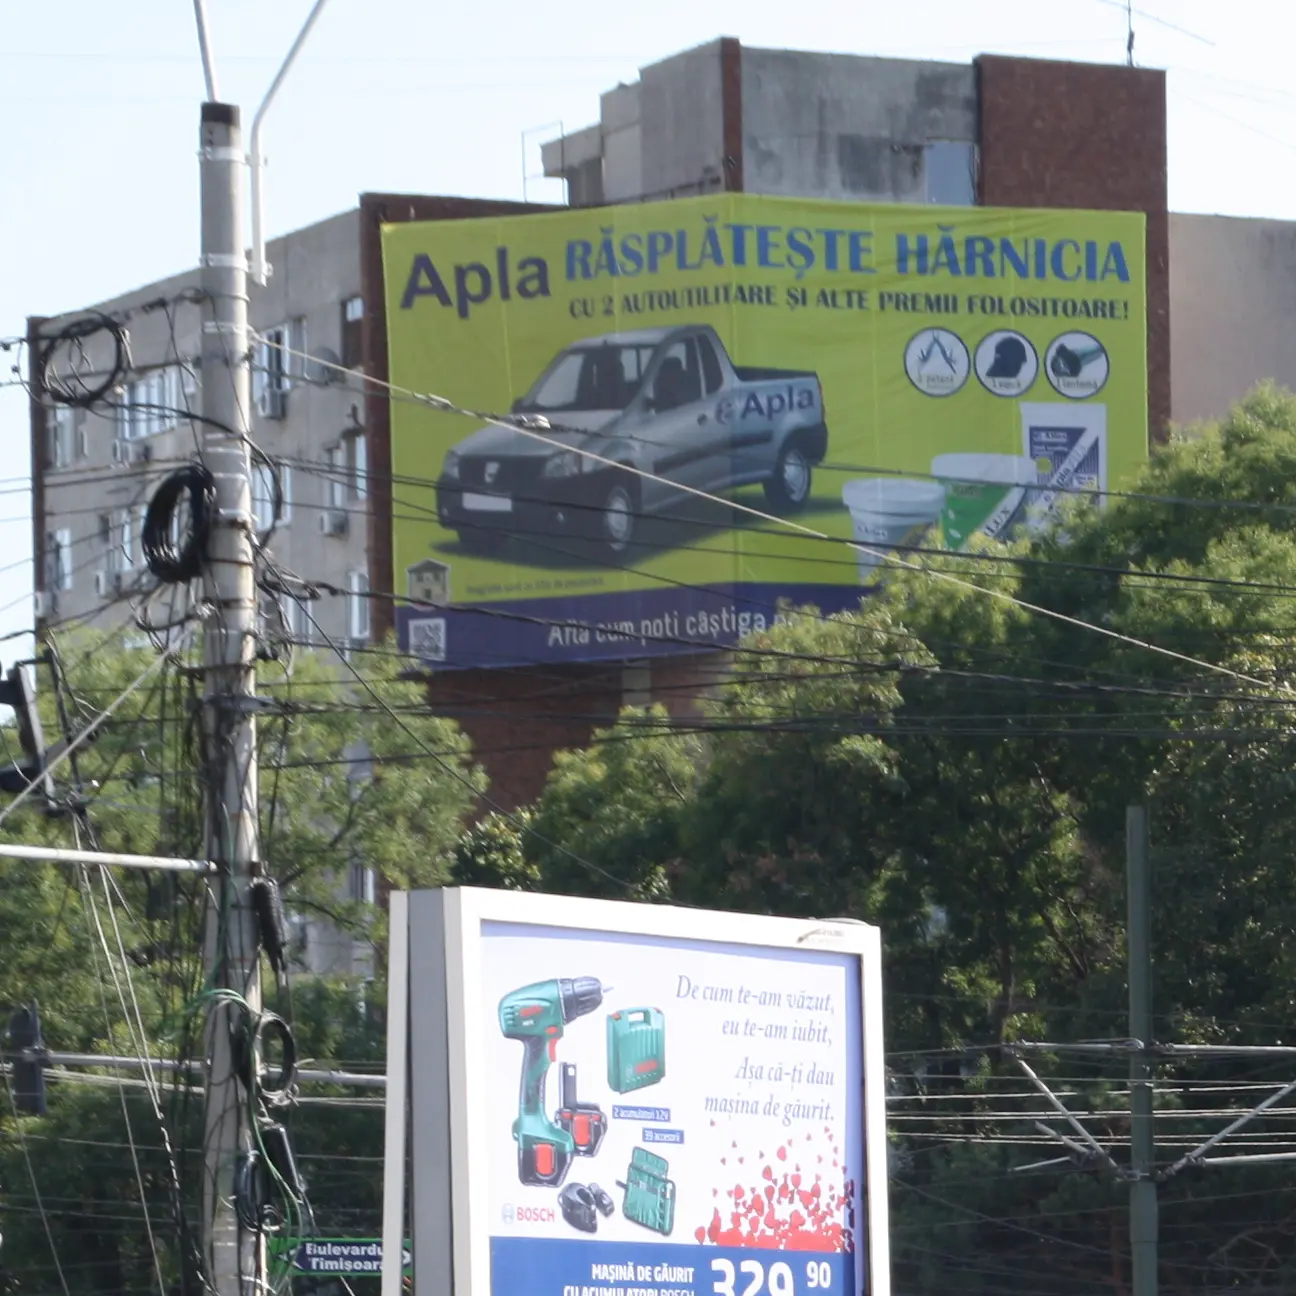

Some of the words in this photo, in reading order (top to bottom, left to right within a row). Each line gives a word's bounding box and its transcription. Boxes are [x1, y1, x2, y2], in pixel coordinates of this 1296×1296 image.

[400, 246, 551, 320] Apla
[895, 224, 1130, 283] HĂRNICIA
[569, 296, 596, 319] CU
[602, 294, 614, 316] 2
[621, 284, 777, 314] AUTOUTILITARE
[815, 288, 870, 310] ALTE
[879, 290, 959, 314] PREMII
[967, 295, 1130, 320] FOLOSITOARE!
[740, 385, 815, 422] Apla
[596, 621, 635, 643] cum
[676, 974, 700, 1000] De
[702, 985, 733, 1003] cum
[737, 985, 782, 1007] te-am
[786, 990, 835, 1015] văzut,
[722, 1019, 740, 1035] eu
[744, 1018, 788, 1040] te-am
[792, 1019, 833, 1047] iubit,
[806, 1062, 835, 1086] dau
[763, 1094, 780, 1117] de
[782, 1098, 835, 1127] găurit.
[516, 1207, 555, 1223] BOSCH
[305, 1242, 384, 1256] Bulevardu
[637, 1265, 652, 1281] DE
[654, 1262, 695, 1284] GĂURIT
[806, 1261, 831, 1288] 90
